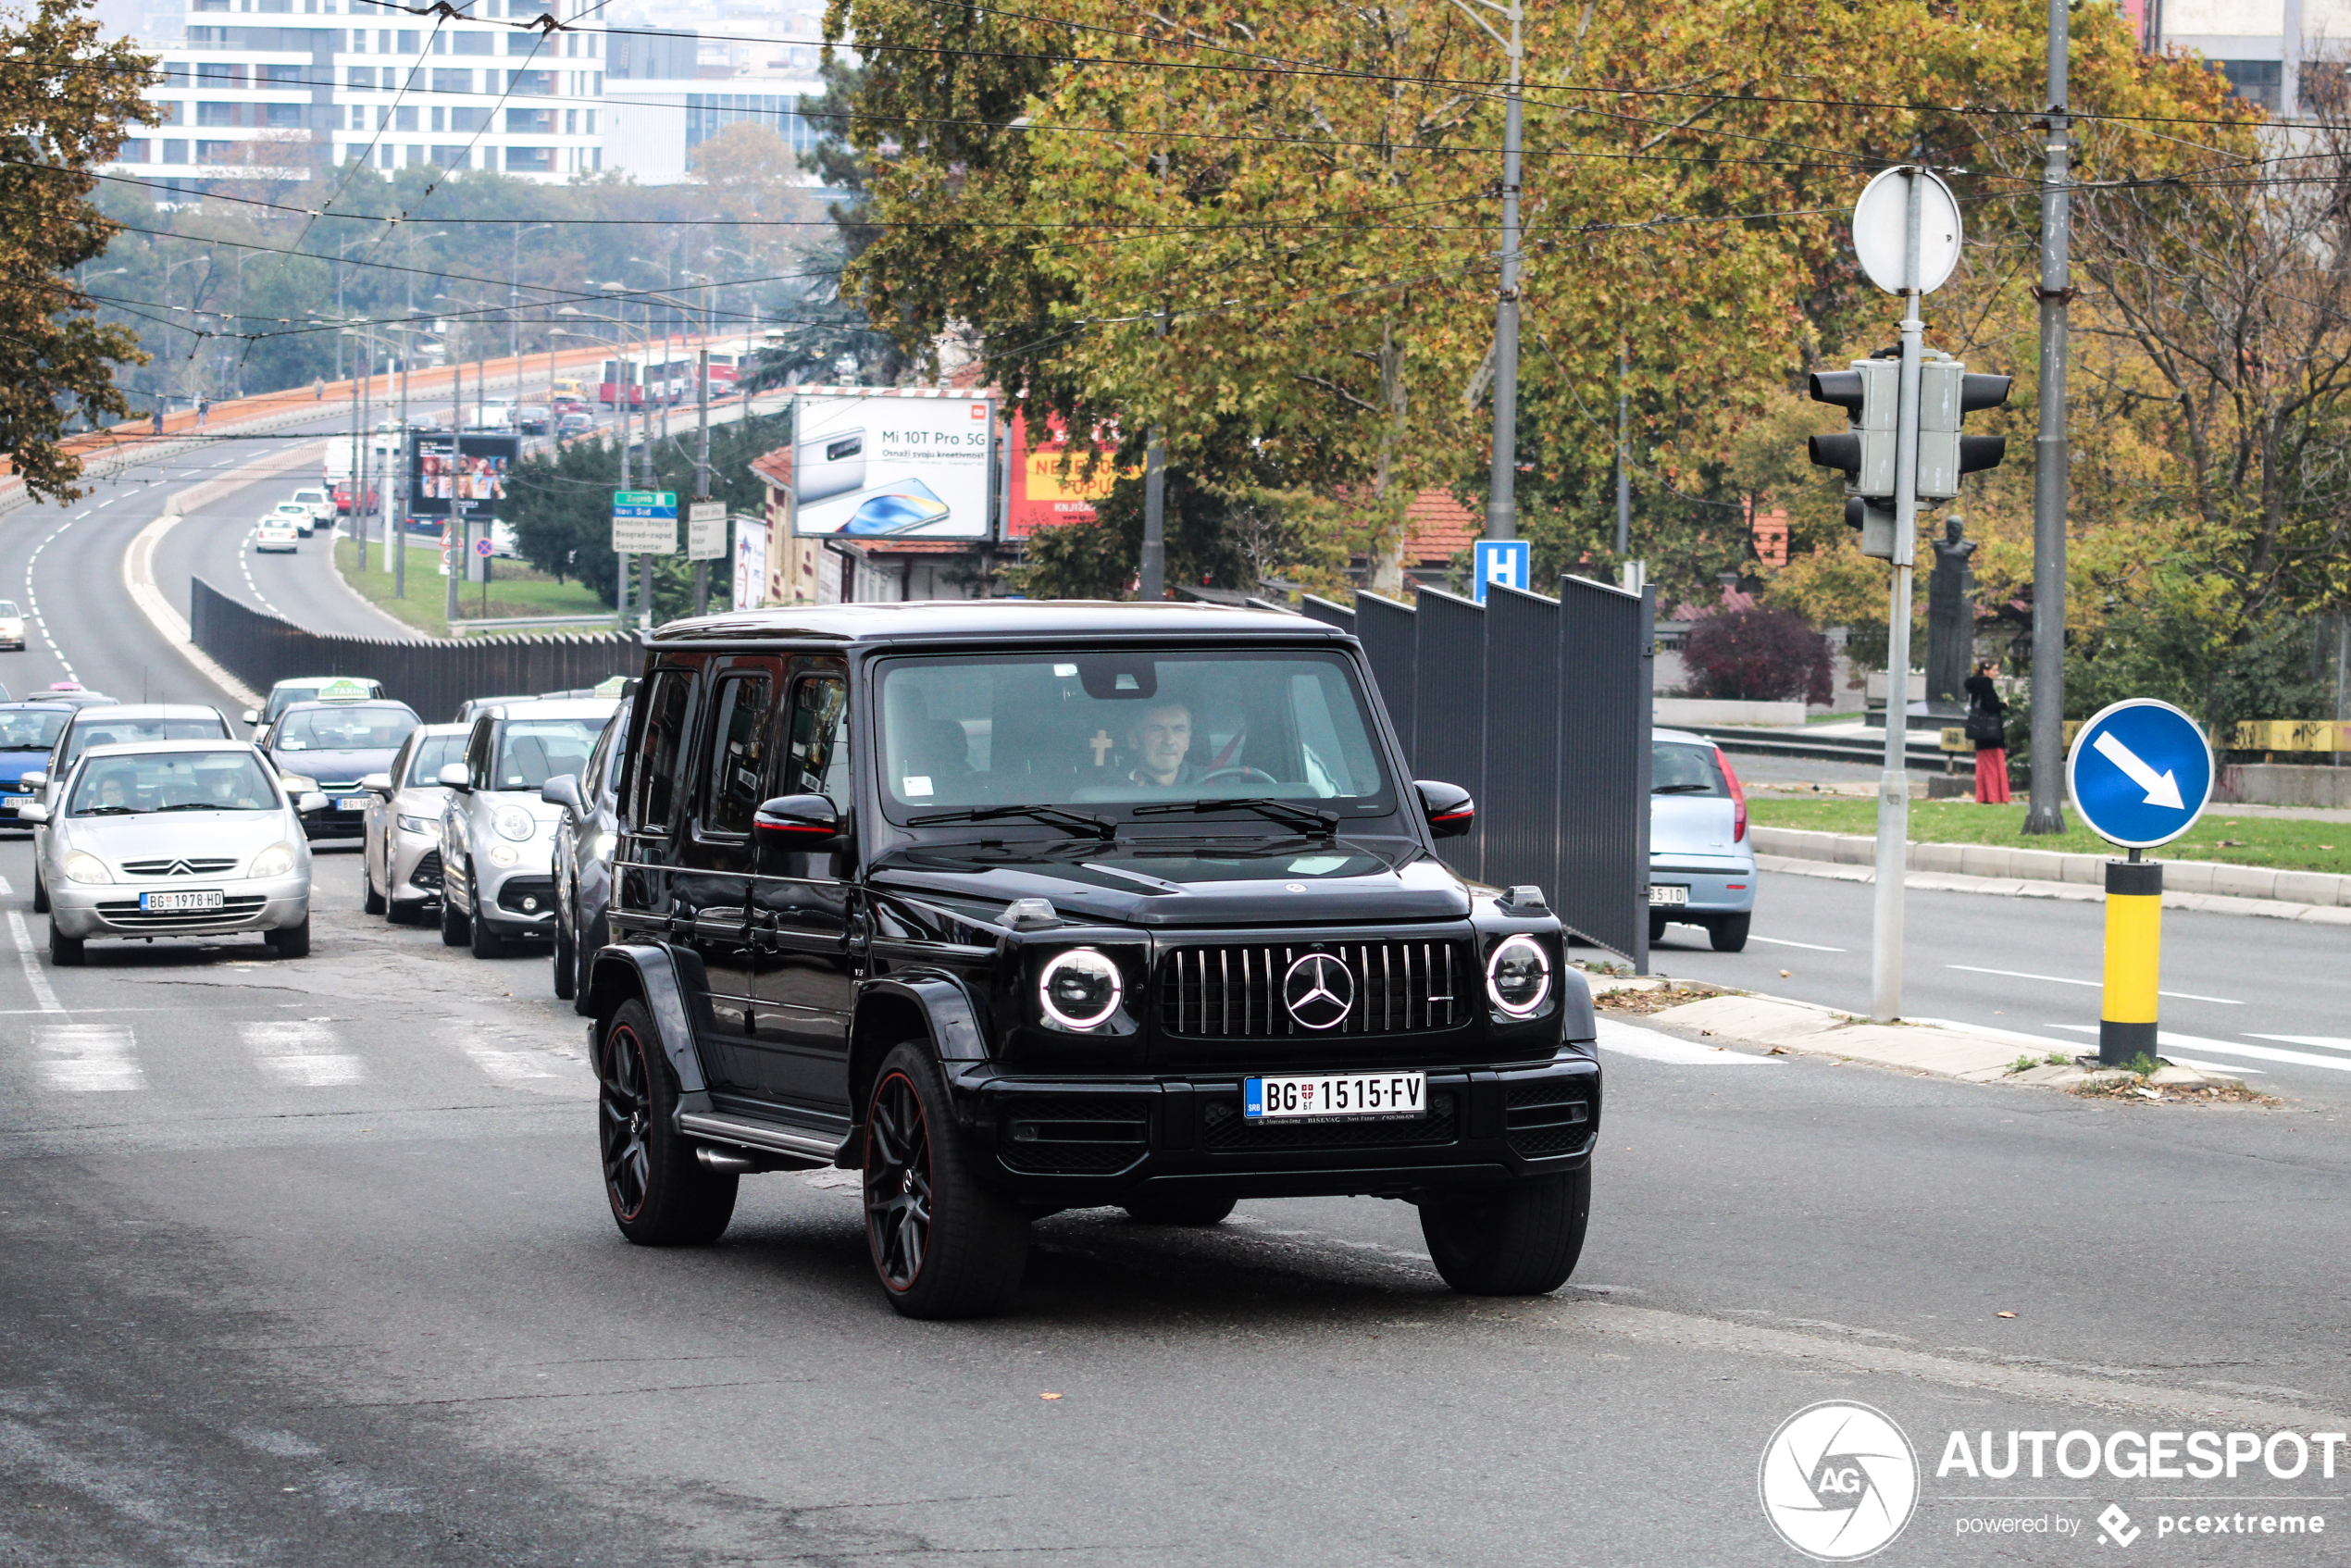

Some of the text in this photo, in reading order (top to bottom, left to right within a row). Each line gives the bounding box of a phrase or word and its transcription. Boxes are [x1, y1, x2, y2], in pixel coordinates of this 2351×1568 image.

[882, 430, 986, 445] Mi 10T Pro 5G
[882, 449, 985, 460] Osnaži svoju kreativnost
[1060, 479, 1112, 495] POPU
[626, 494, 653, 503] Zagreb
[1054, 500, 1096, 512] KNJIŽA
[616, 530, 672, 540] Beograd-zapad
[616, 541, 663, 550] Sava-centar
[343, 800, 354, 808] BG
[150, 892, 221, 908] BG 1978-HD
[1267, 1077, 1421, 1112] BG 1515-FV
[1248, 1103, 1261, 1112] SRB
